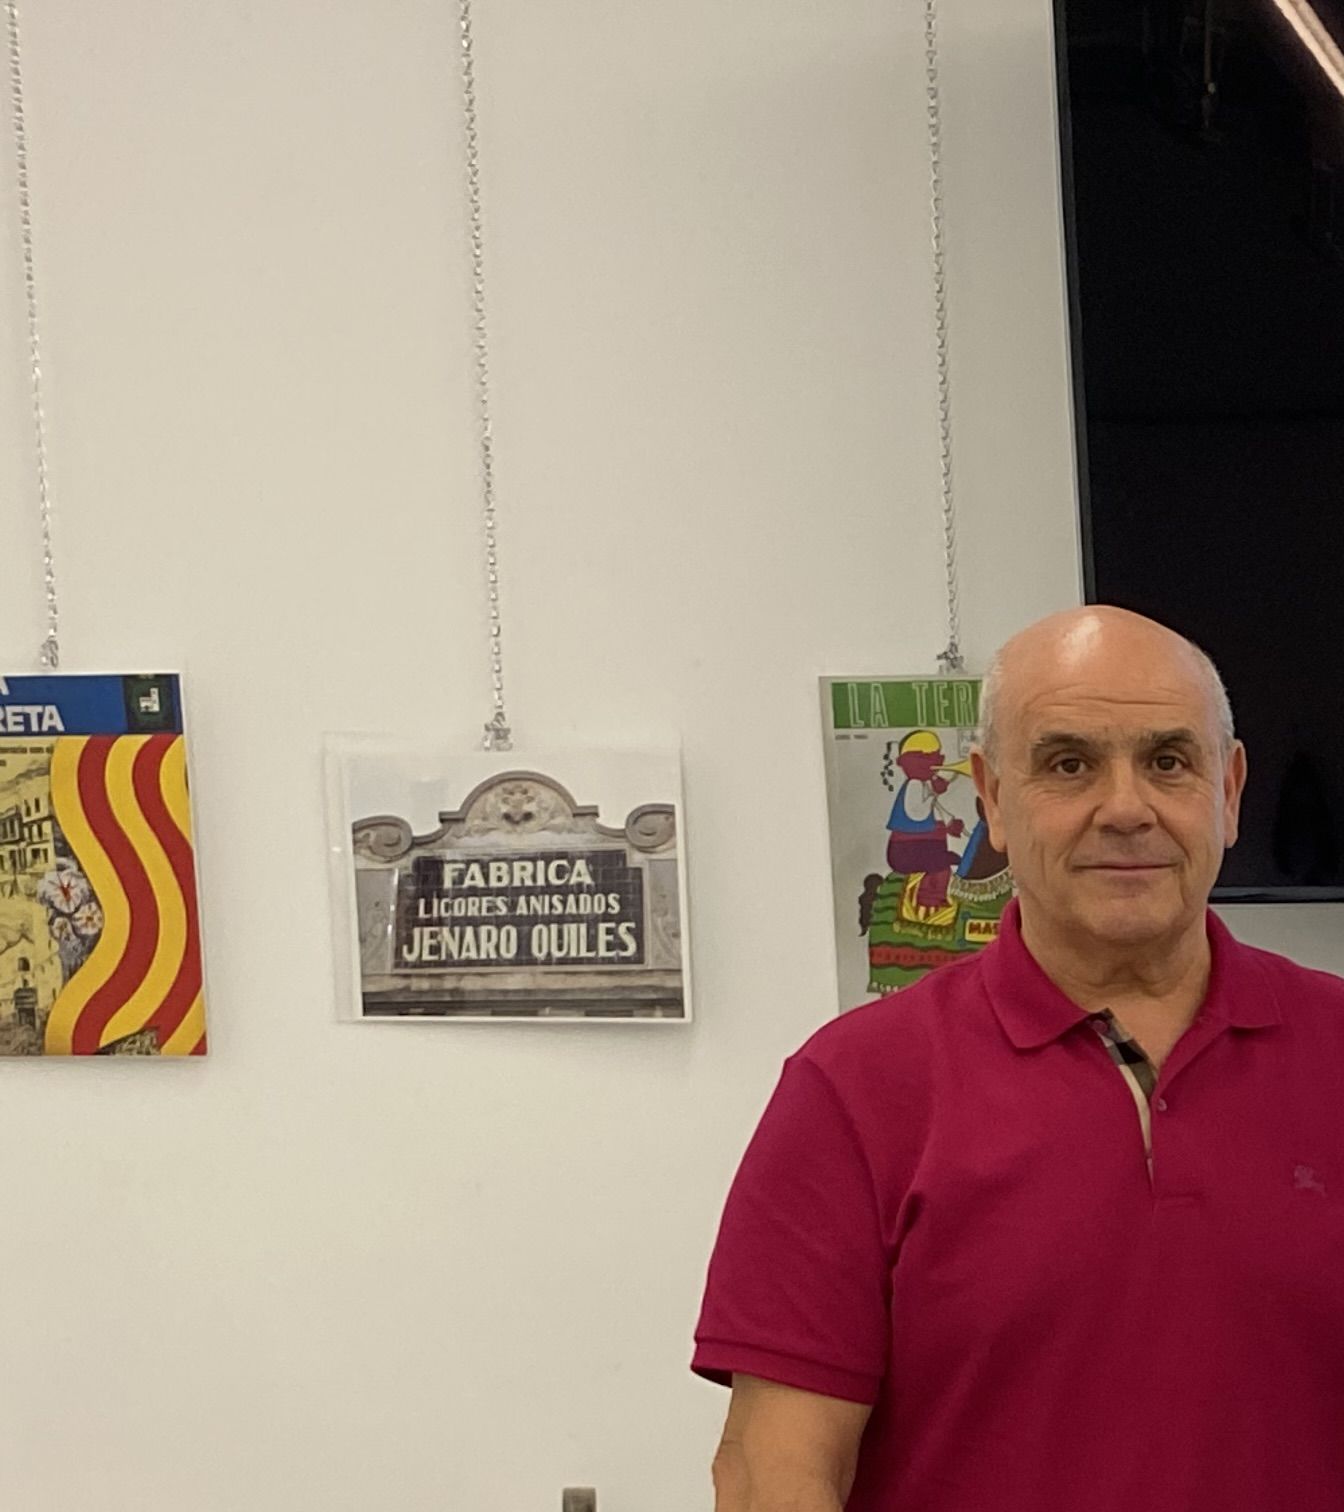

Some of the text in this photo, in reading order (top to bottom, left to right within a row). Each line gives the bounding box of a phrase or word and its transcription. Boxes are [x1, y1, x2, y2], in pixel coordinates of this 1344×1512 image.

[848, 682, 975, 728] LA TER
[443, 858, 596, 889] FABRICA
[418, 893, 622, 919] LICORES ANISADOS
[402, 921, 638, 962] JENARO QUILES
